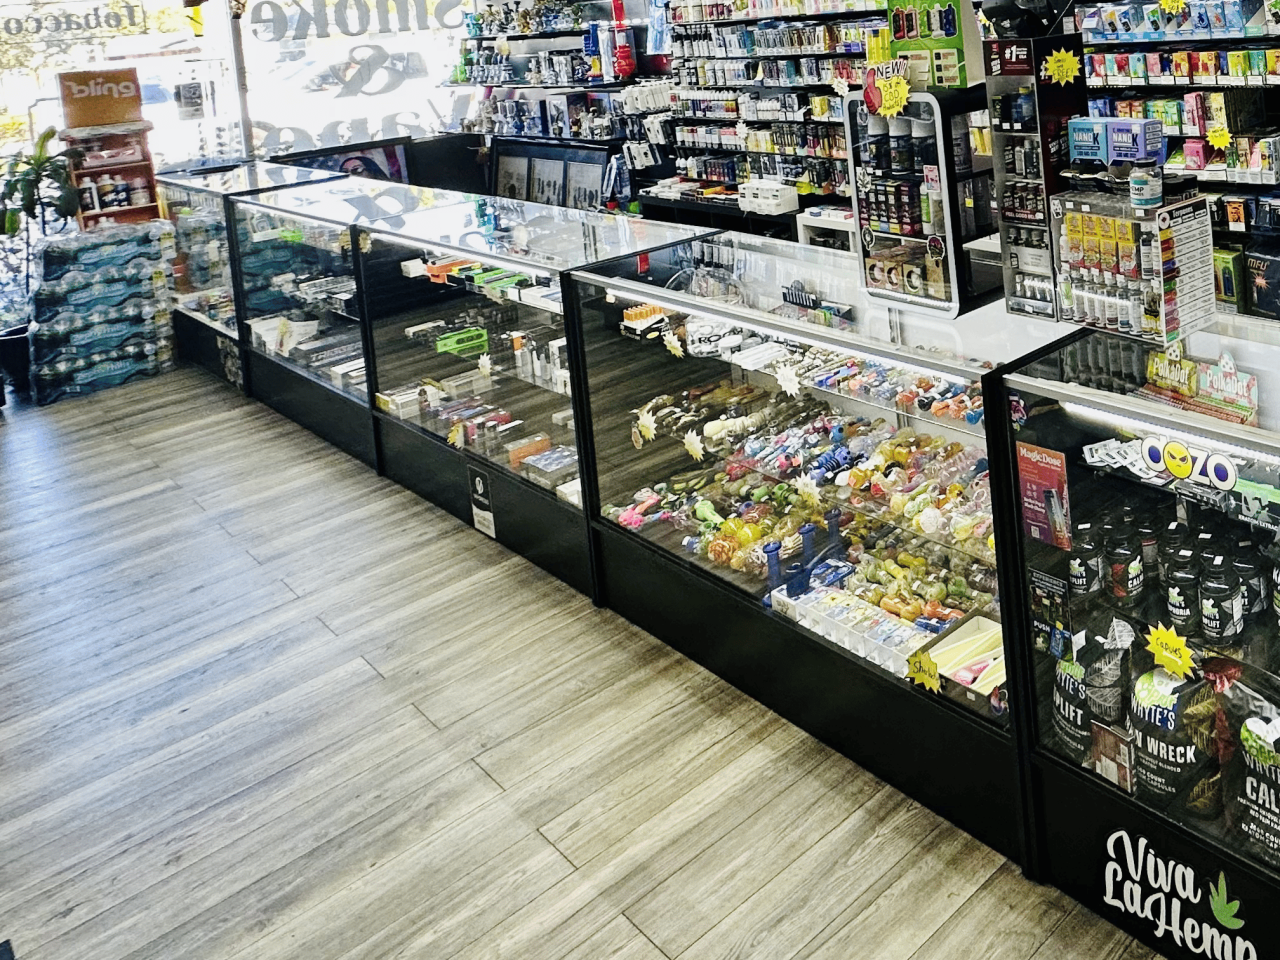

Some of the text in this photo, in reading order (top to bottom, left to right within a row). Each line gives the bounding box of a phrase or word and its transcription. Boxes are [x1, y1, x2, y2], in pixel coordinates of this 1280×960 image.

[876, 60, 906, 80] NEW!
[1153, 358, 1189, 384] PolkaDot
[1206, 369, 1248, 397] PolkaDot
[1146, 735, 1196, 763] WRECK
[1106, 830, 1201, 903] Viva
